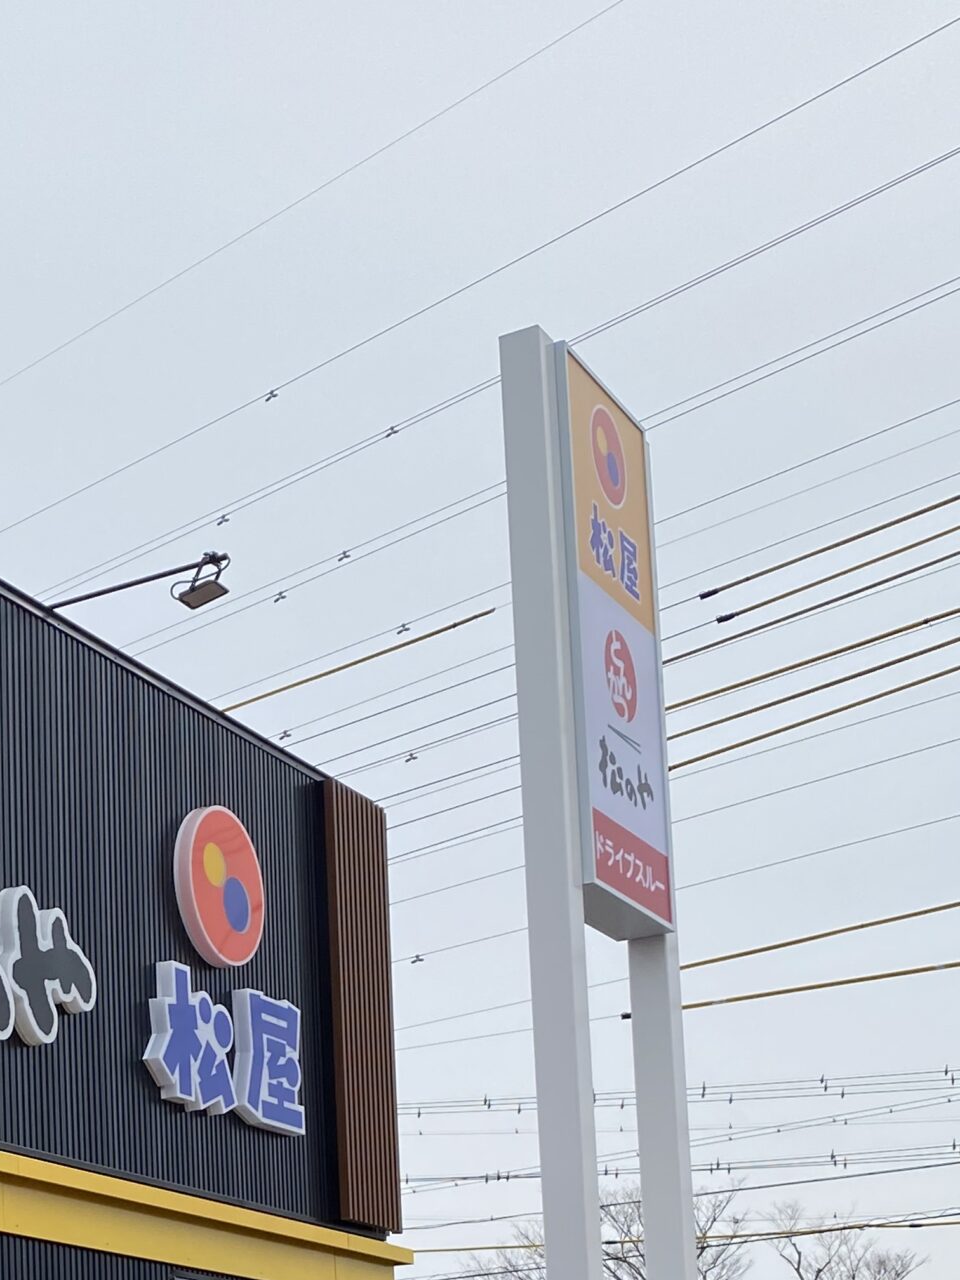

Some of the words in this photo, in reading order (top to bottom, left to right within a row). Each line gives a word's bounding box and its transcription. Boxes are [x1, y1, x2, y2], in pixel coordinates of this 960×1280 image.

[590, 502, 640, 601] 松屋
[598, 735, 654, 810] 松のや
[595, 831, 665, 892] ドライブスルー
[152, 963, 305, 1133] 松屋
